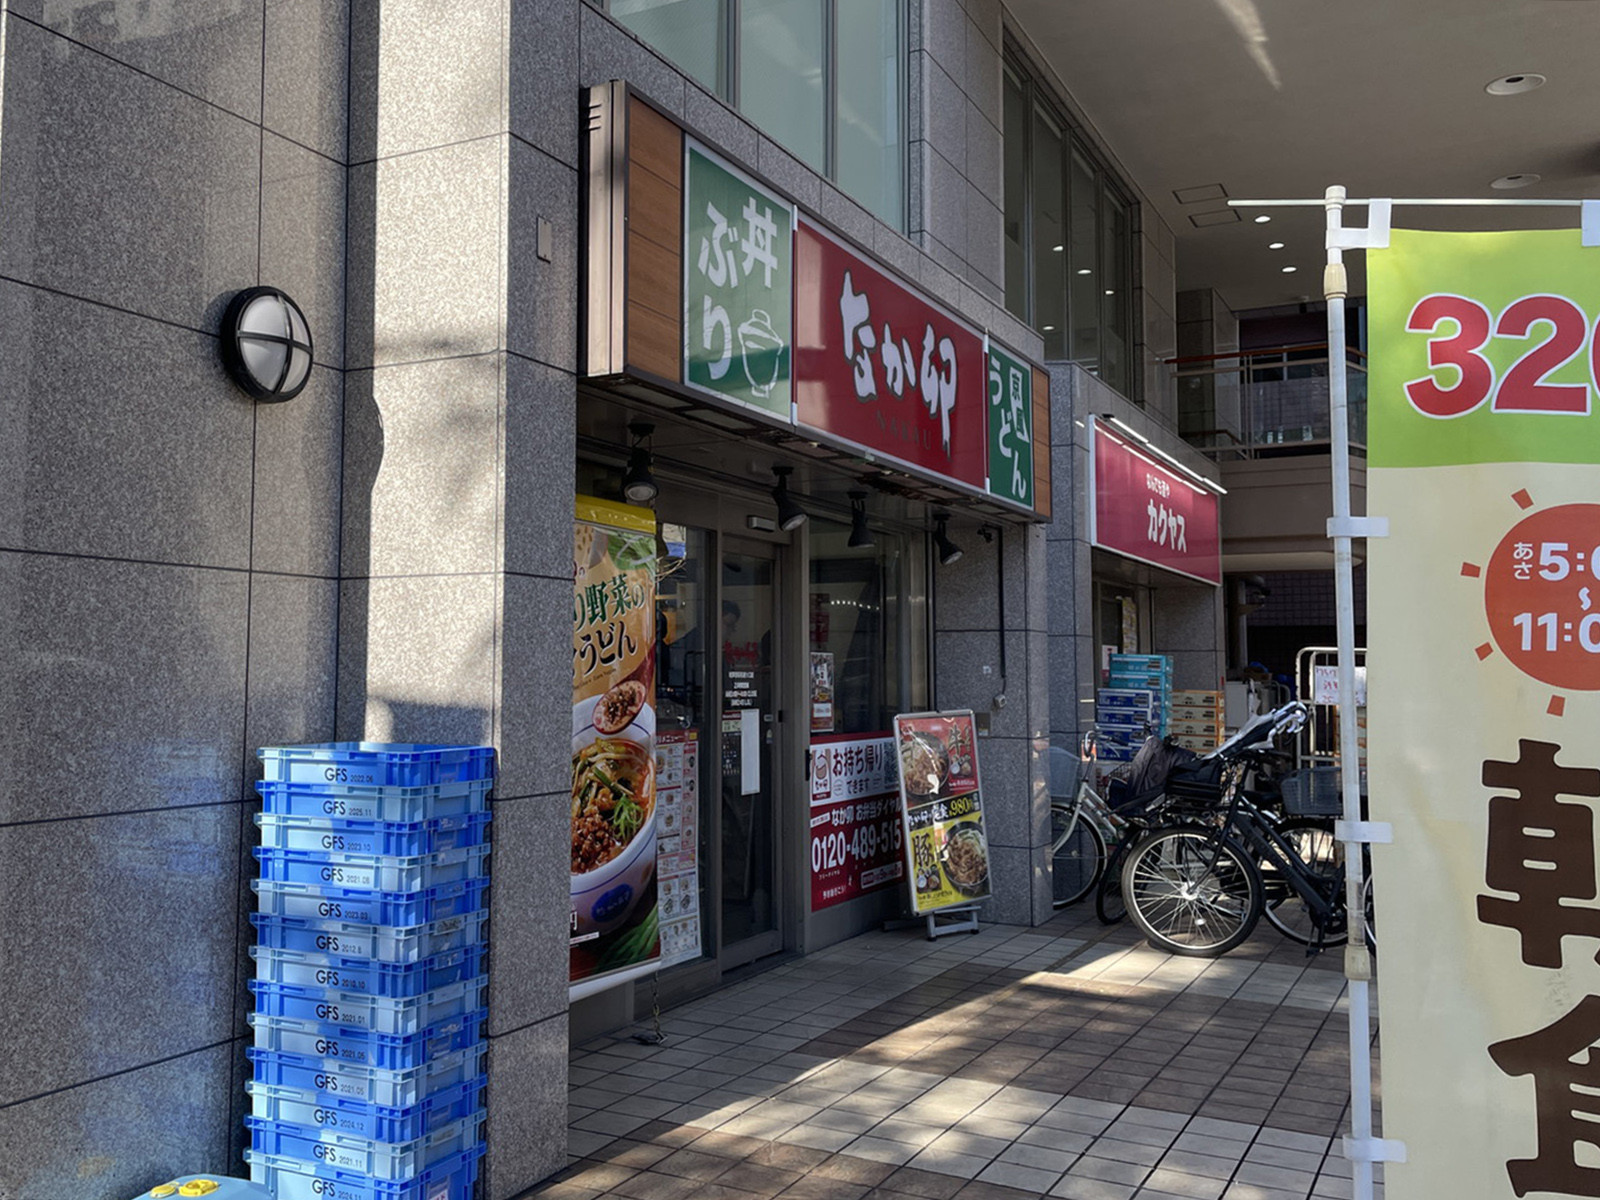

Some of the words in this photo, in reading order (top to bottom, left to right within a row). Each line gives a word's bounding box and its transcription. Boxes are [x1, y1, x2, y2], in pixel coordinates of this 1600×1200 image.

[742, 197, 777, 288] 丼
[698, 201, 738, 380] ぶり
[1402, 292, 1600, 420] 32
[989, 355, 1027, 499] うどん
[1147, 498, 1187, 553] カクヤス
[1513, 541, 1534, 580] あさ
[1538, 542, 1600, 582] 5:
[324, 767, 348, 782] GFS
[322, 800, 346, 815] GFS
[321, 835, 345, 850] GFS
[812, 819, 902, 873] 0120-489-515
[320, 867, 344, 882] GFS
[318, 902, 342, 918] GFS
[316, 935, 339, 951] GFS
[316, 969, 339, 986] GFS
[316, 1004, 339, 1021] GFS
[315, 1039, 339, 1056] GFS
[314, 1074, 338, 1091] GFS
[313, 1108, 337, 1126] GFS
[313, 1144, 336, 1162] GFS
[312, 1179, 335, 1197] GFS
